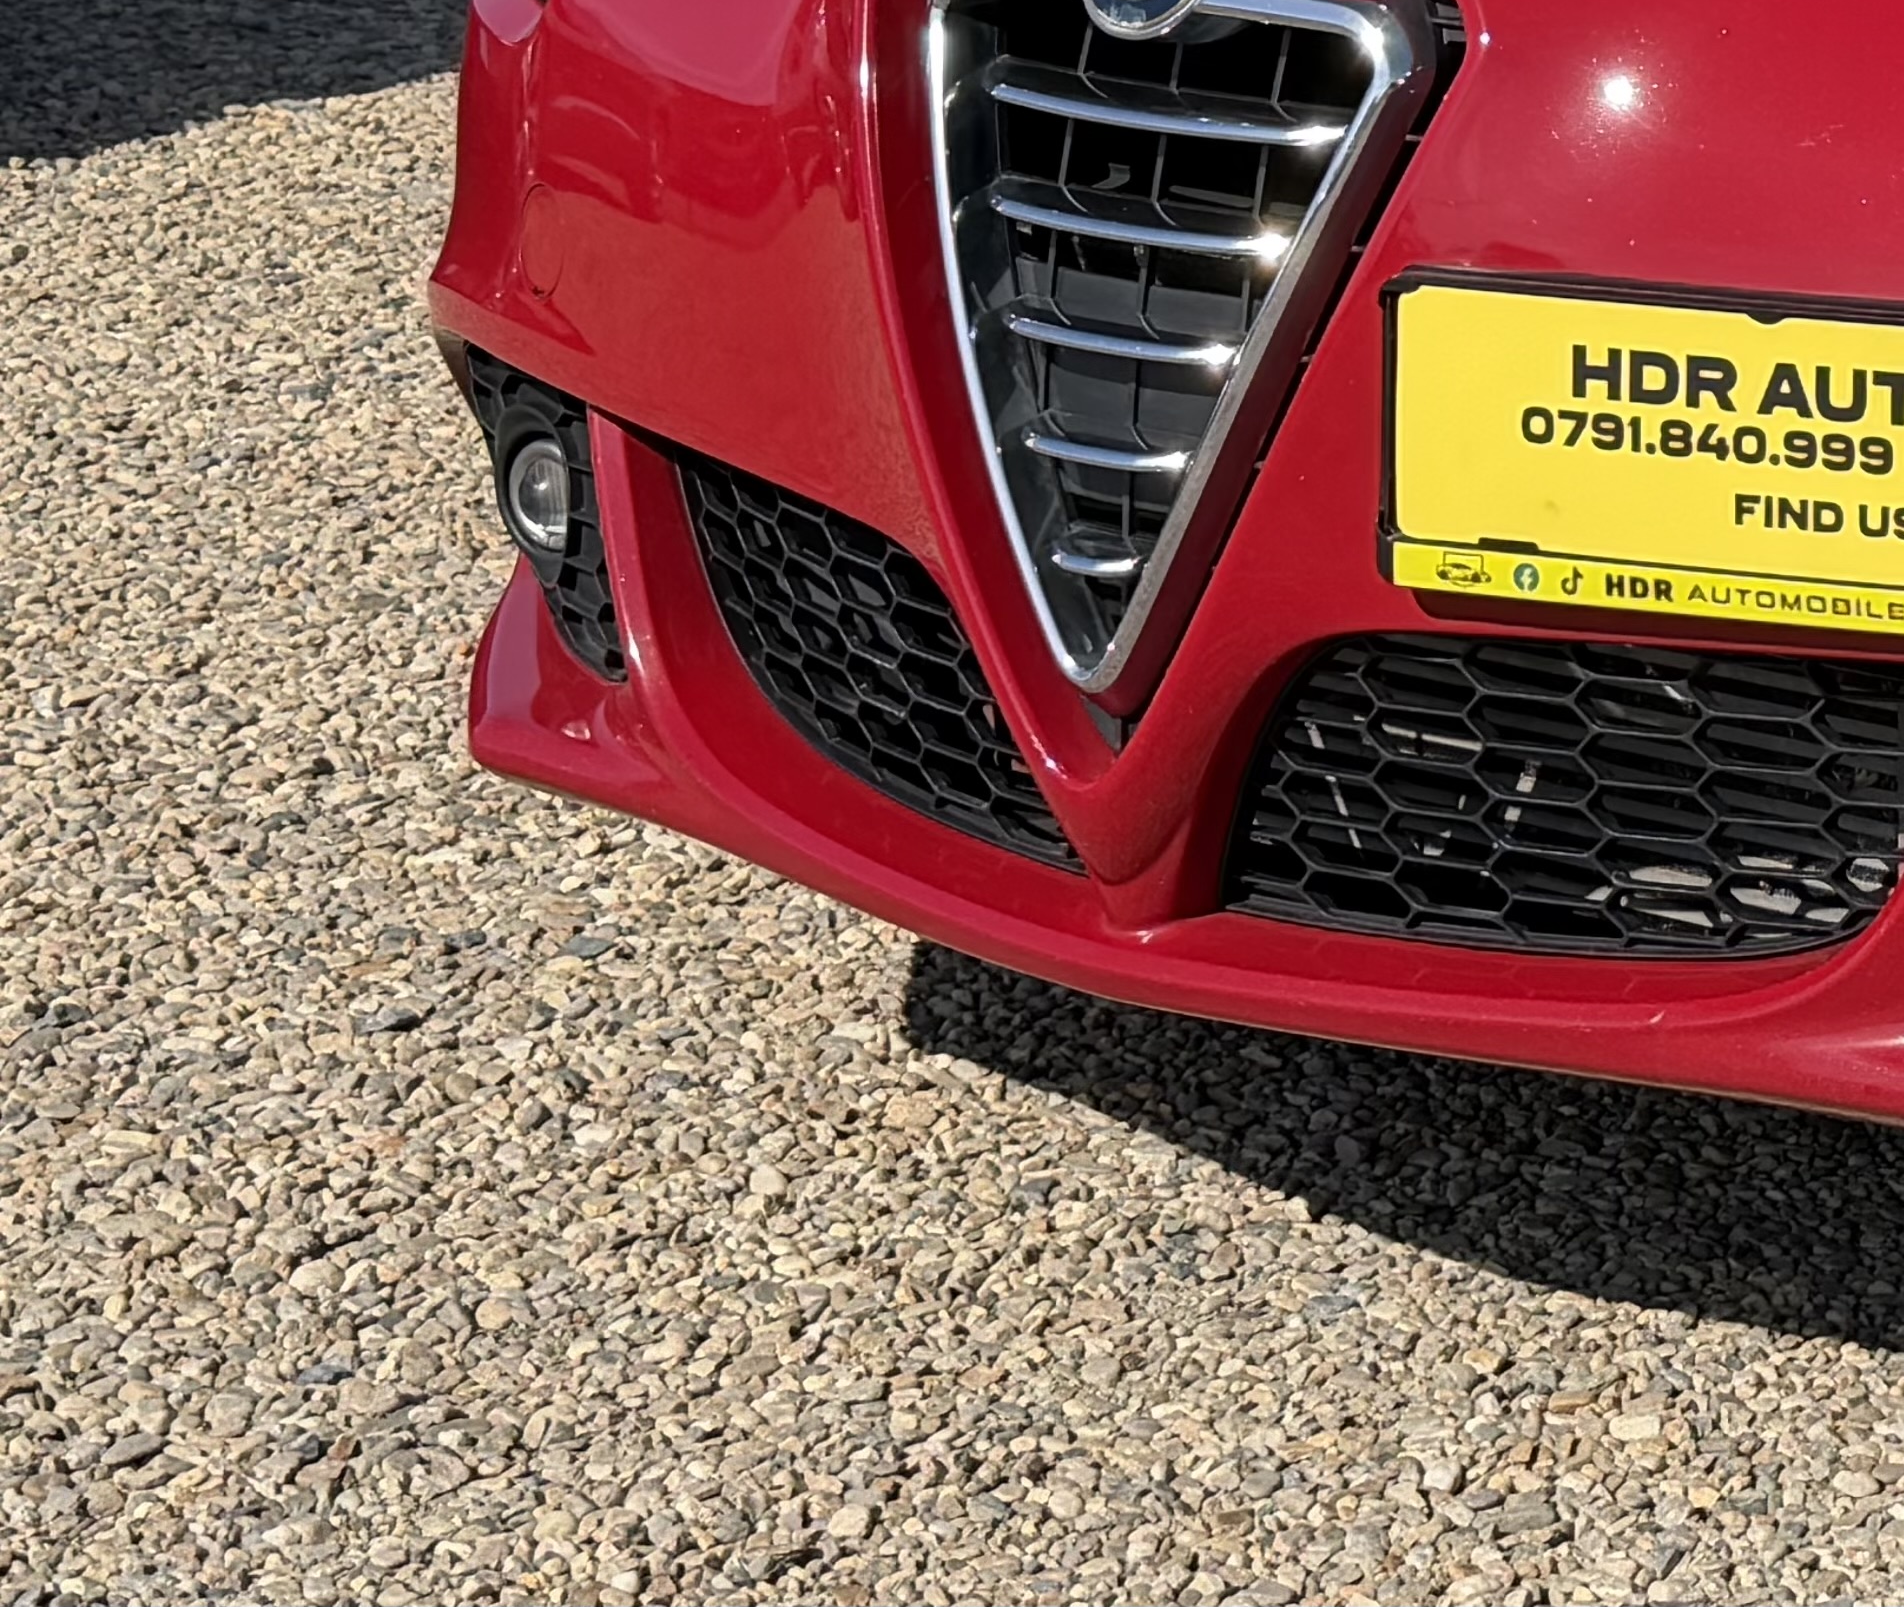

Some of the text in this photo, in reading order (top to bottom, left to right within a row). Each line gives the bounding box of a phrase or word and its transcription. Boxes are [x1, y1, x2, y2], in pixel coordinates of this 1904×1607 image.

[1571, 343, 1738, 413] HDR
[1520, 405, 1894, 476] 0791.840.999
[1733, 492, 1845, 534] FIND
[1604, 571, 1674, 603] HDR
